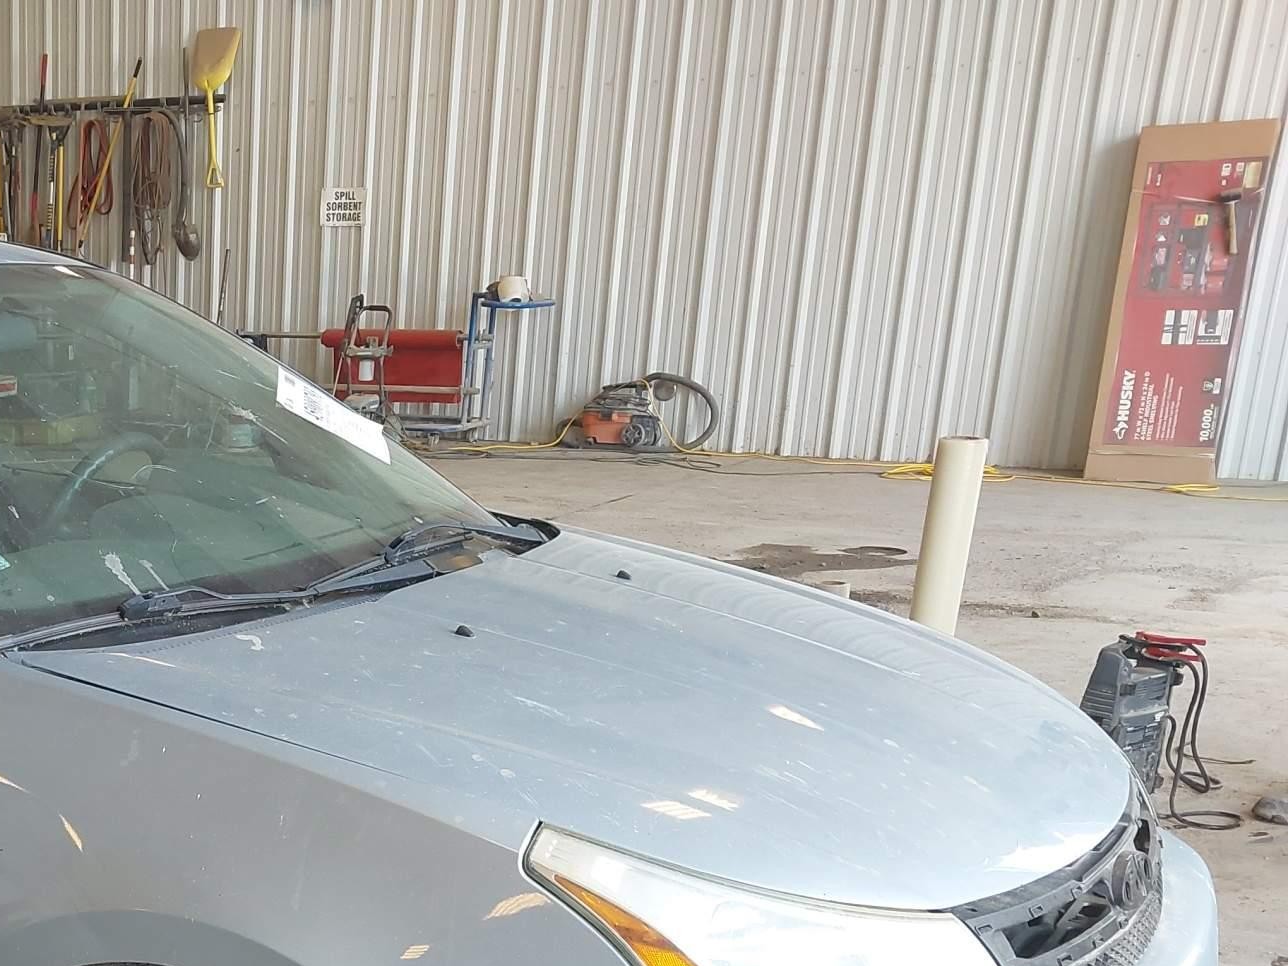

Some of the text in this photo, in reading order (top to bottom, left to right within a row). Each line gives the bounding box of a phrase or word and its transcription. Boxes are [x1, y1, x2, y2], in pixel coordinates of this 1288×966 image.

[334, 191, 356, 201] SPILL
[326, 201, 362, 211] SORBENT
[326, 212, 361, 222] STORAGE
[1117, 369, 1136, 421] HUSKY
[1199, 409, 1213, 442] 10,000
